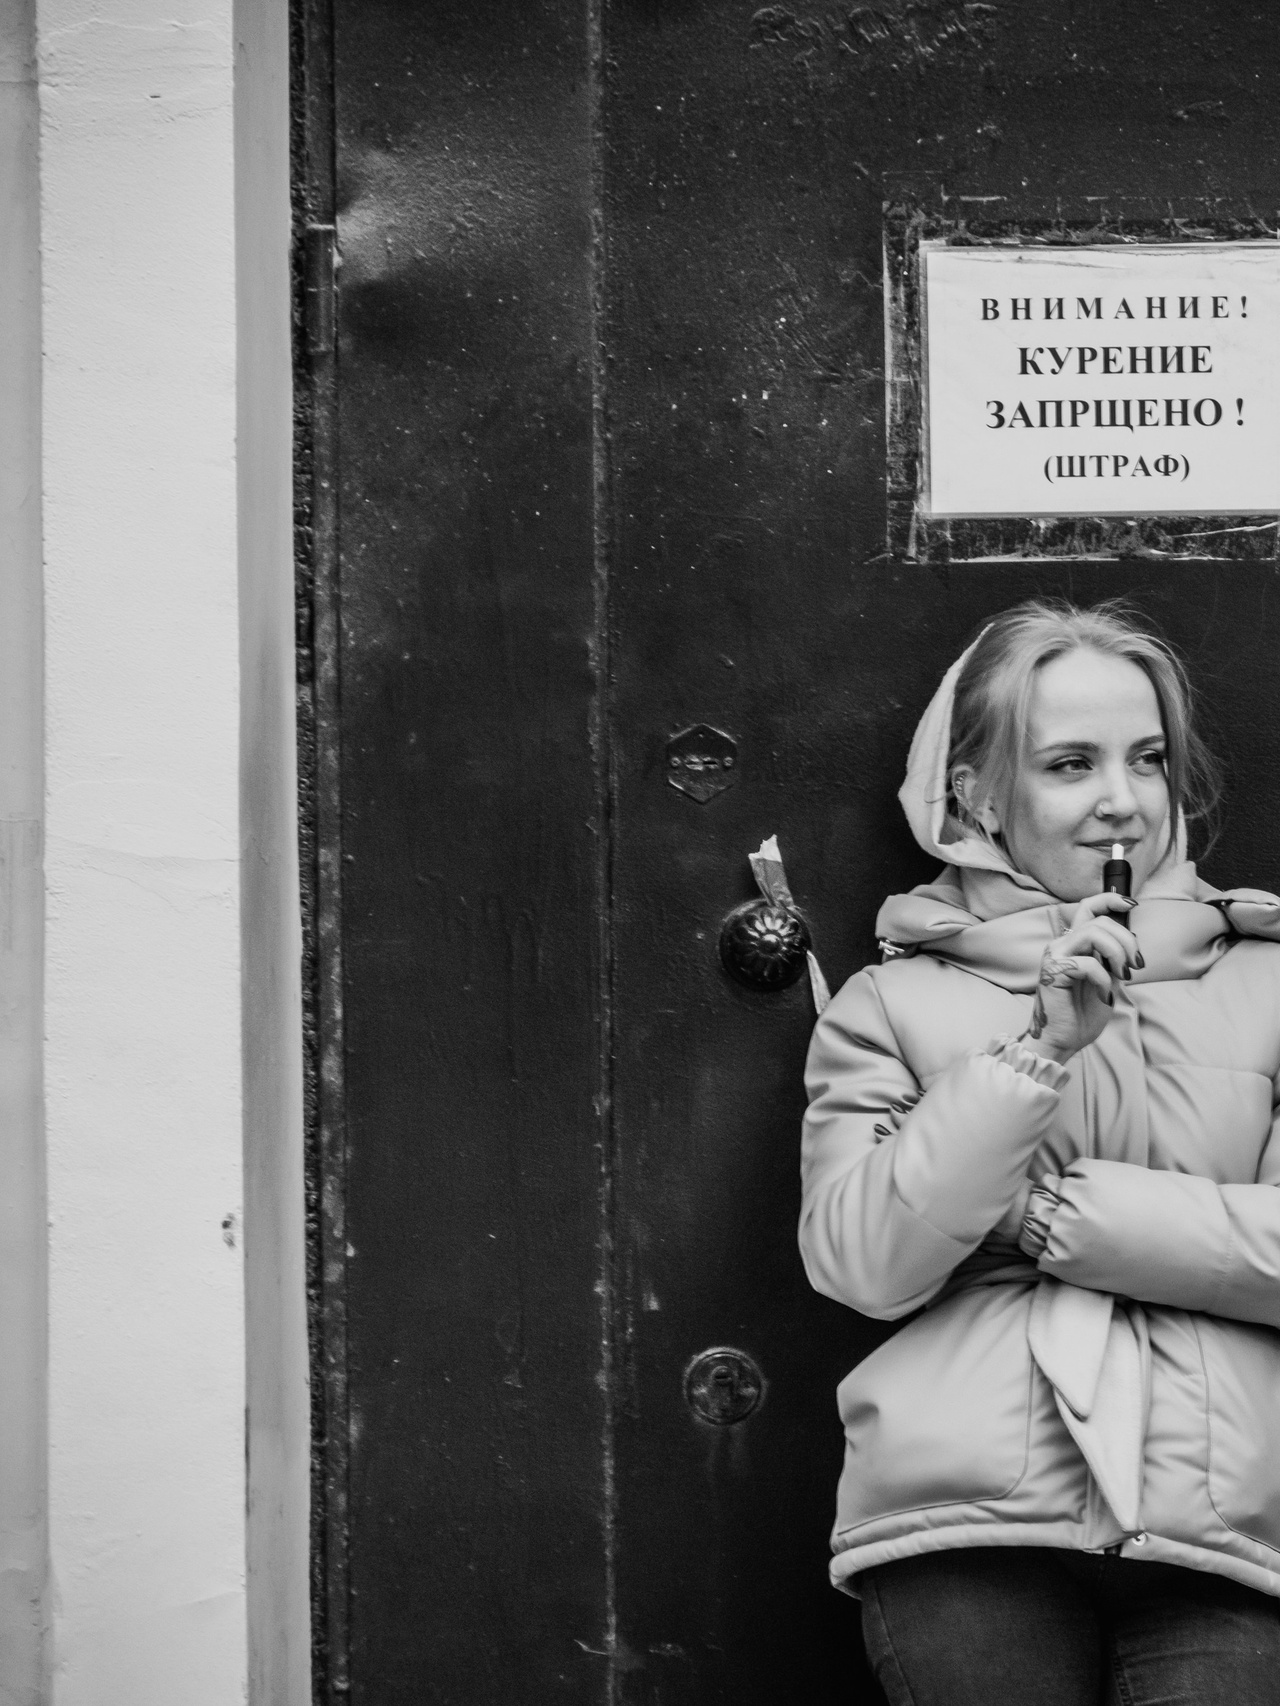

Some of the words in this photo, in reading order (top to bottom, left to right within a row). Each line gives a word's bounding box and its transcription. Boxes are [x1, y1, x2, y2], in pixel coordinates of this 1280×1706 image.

[981, 295, 1248, 321] ВНИМАНИЕ!
[1017, 345, 1214, 375] КУРЕНИЕ
[1043, 454, 1191, 484] (ШТРАФ)
